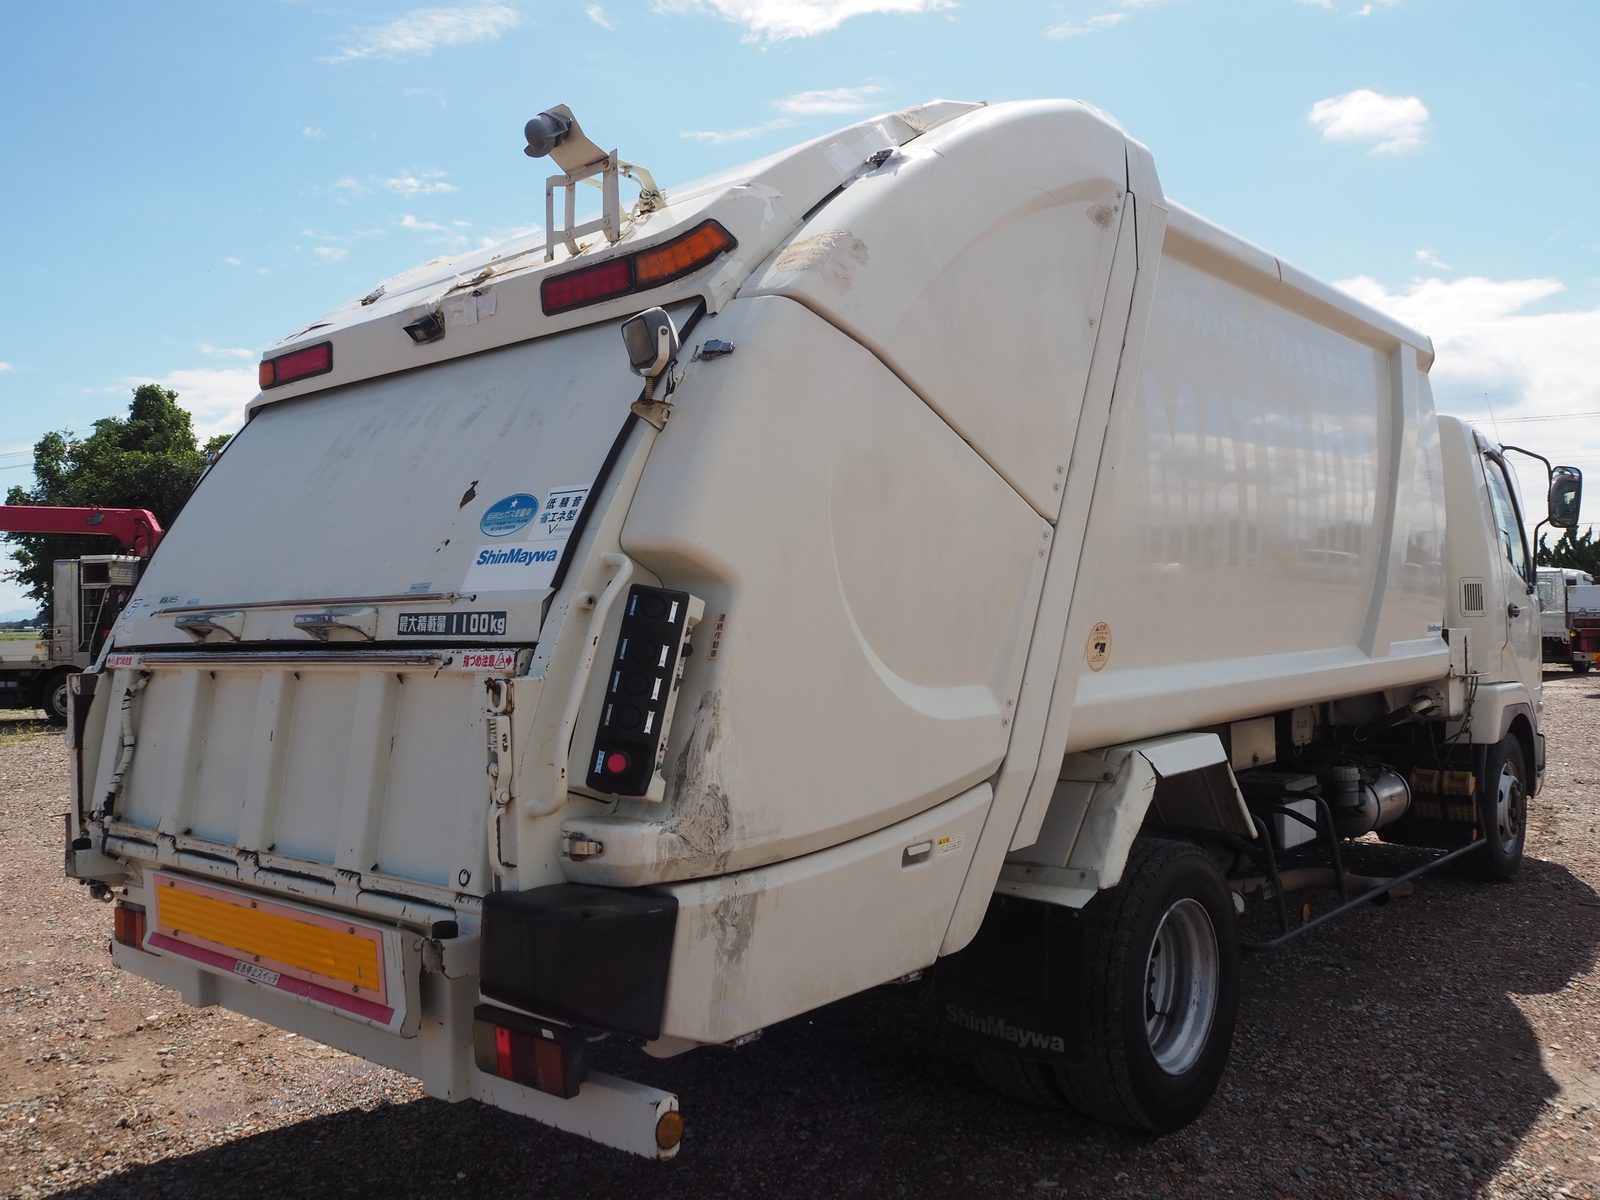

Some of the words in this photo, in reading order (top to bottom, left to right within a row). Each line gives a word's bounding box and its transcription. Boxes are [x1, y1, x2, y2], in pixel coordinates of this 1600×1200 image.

[545, 495, 583, 510] 低騒音
[540, 509, 578, 523] 省エネ型
[476, 548, 558, 566] ShinMaywa
[399, 615, 447, 633] 最大積載量
[452, 614, 505, 634] 1100kg
[462, 654, 495, 667] 指づめ注意
[945, 1003, 1064, 1053] ShinMaywa
